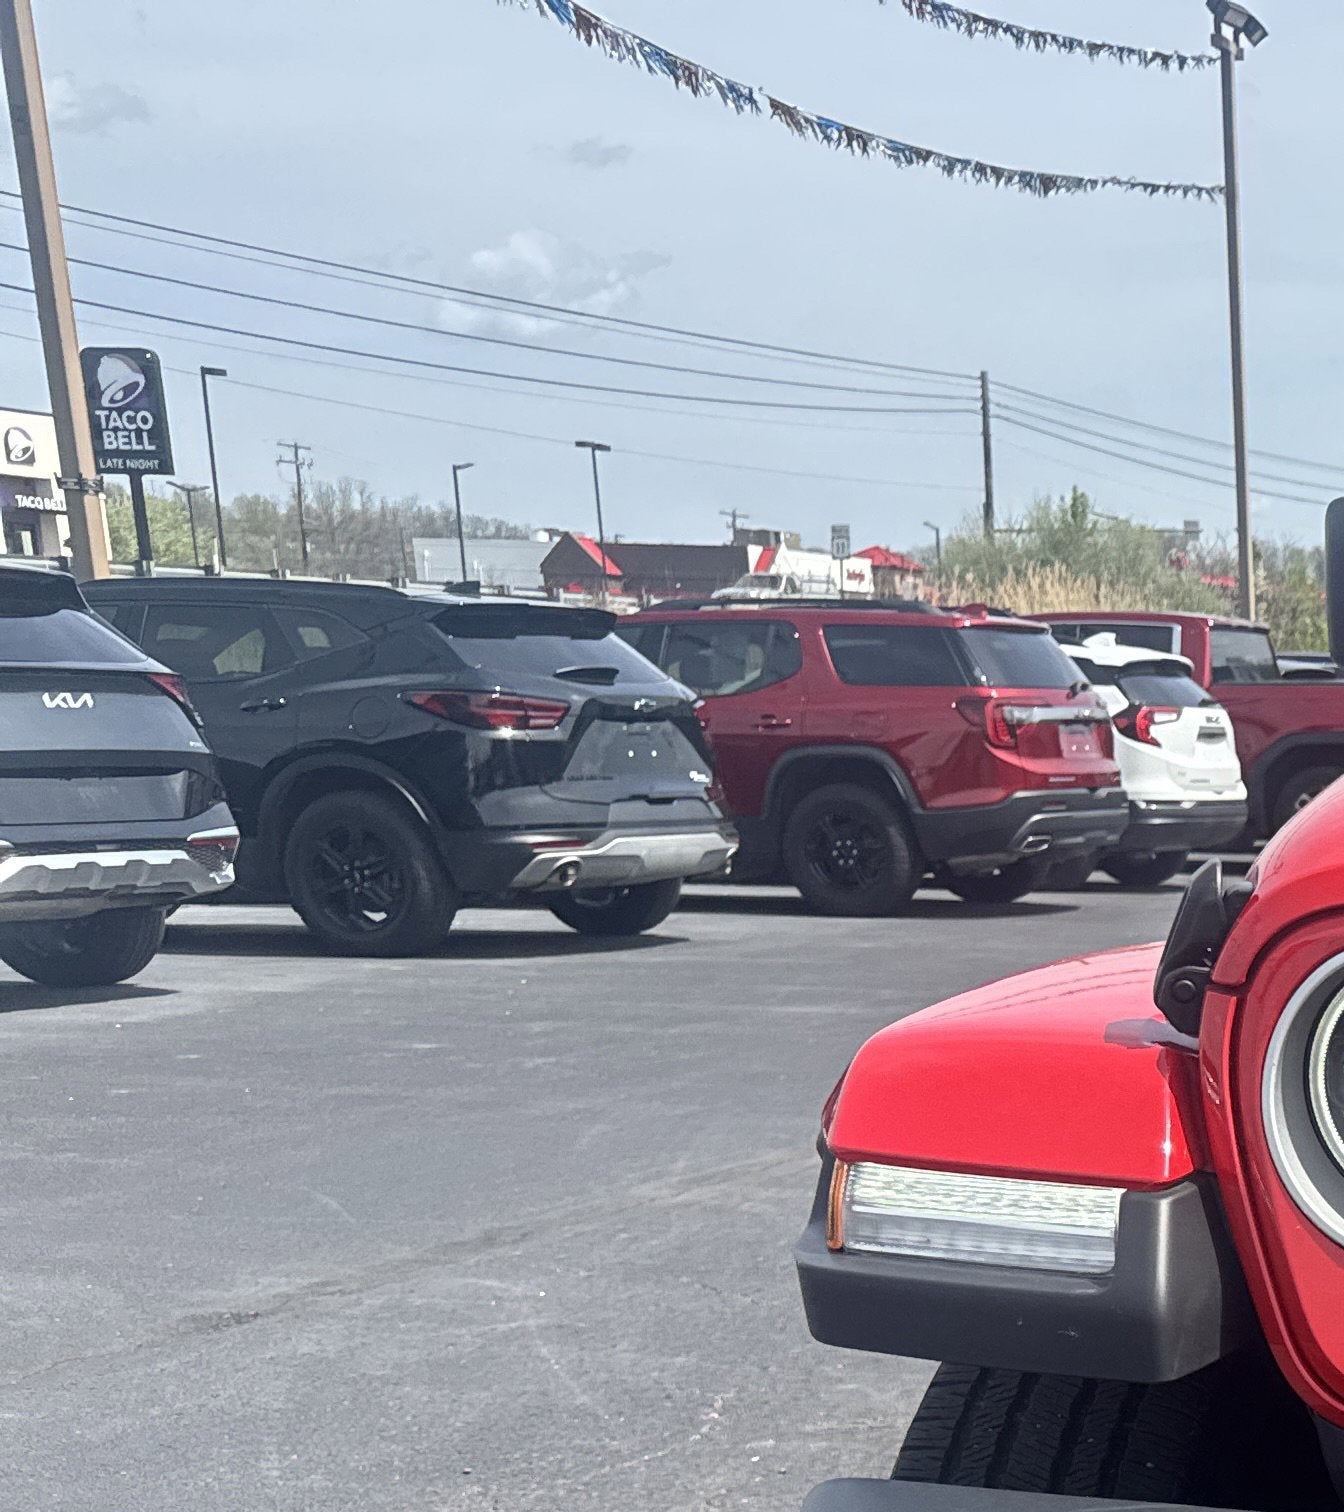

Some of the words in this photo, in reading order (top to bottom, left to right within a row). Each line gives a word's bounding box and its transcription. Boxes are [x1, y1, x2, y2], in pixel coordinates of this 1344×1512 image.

[95, 410, 153, 430] TACO
[102, 431, 156, 450] BELL
[99, 458, 124, 469] LATE
[125, 459, 160, 470] NIGHT
[14, 494, 44, 510] TACO
